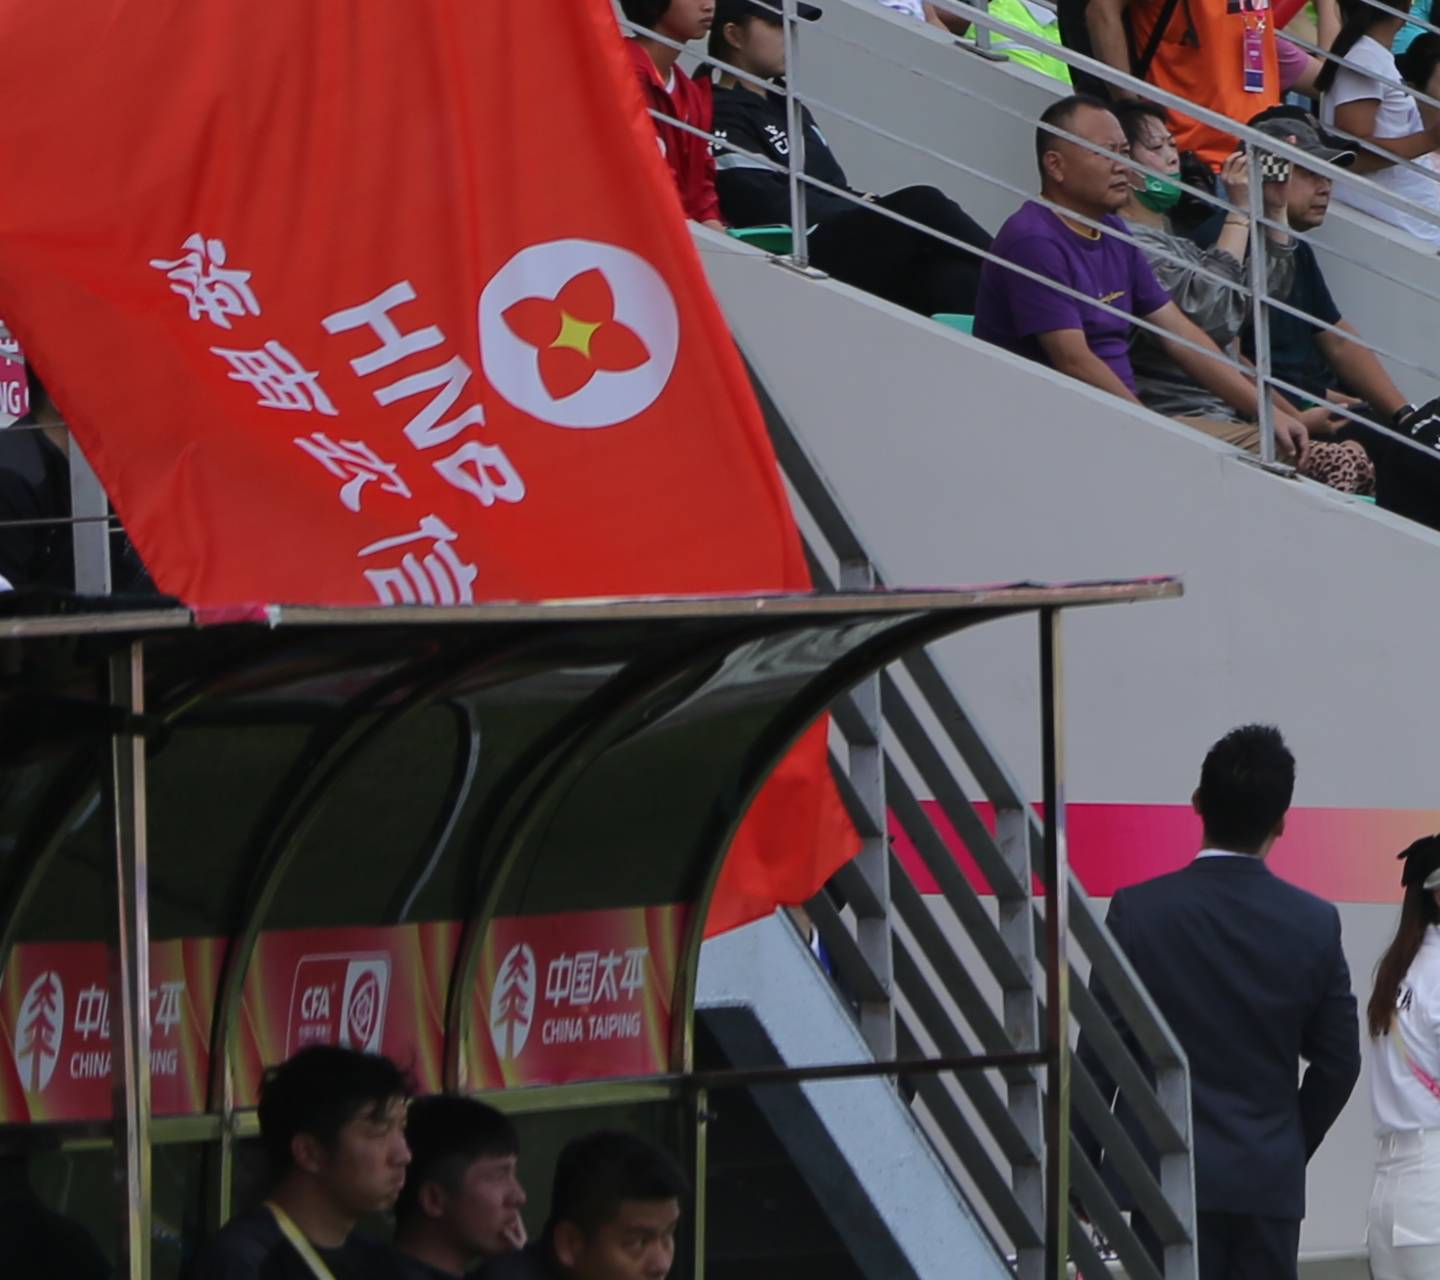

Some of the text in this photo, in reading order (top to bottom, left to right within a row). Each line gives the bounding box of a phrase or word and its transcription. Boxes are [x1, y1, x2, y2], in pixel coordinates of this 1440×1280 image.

[147, 231, 479, 606] 海南农信
[321, 280, 528, 506] HNB
[301, 987, 332, 1020] CFA
[544, 946, 650, 1007] 中国太平
[542, 1009, 642, 1046] CHINA TAIPING
